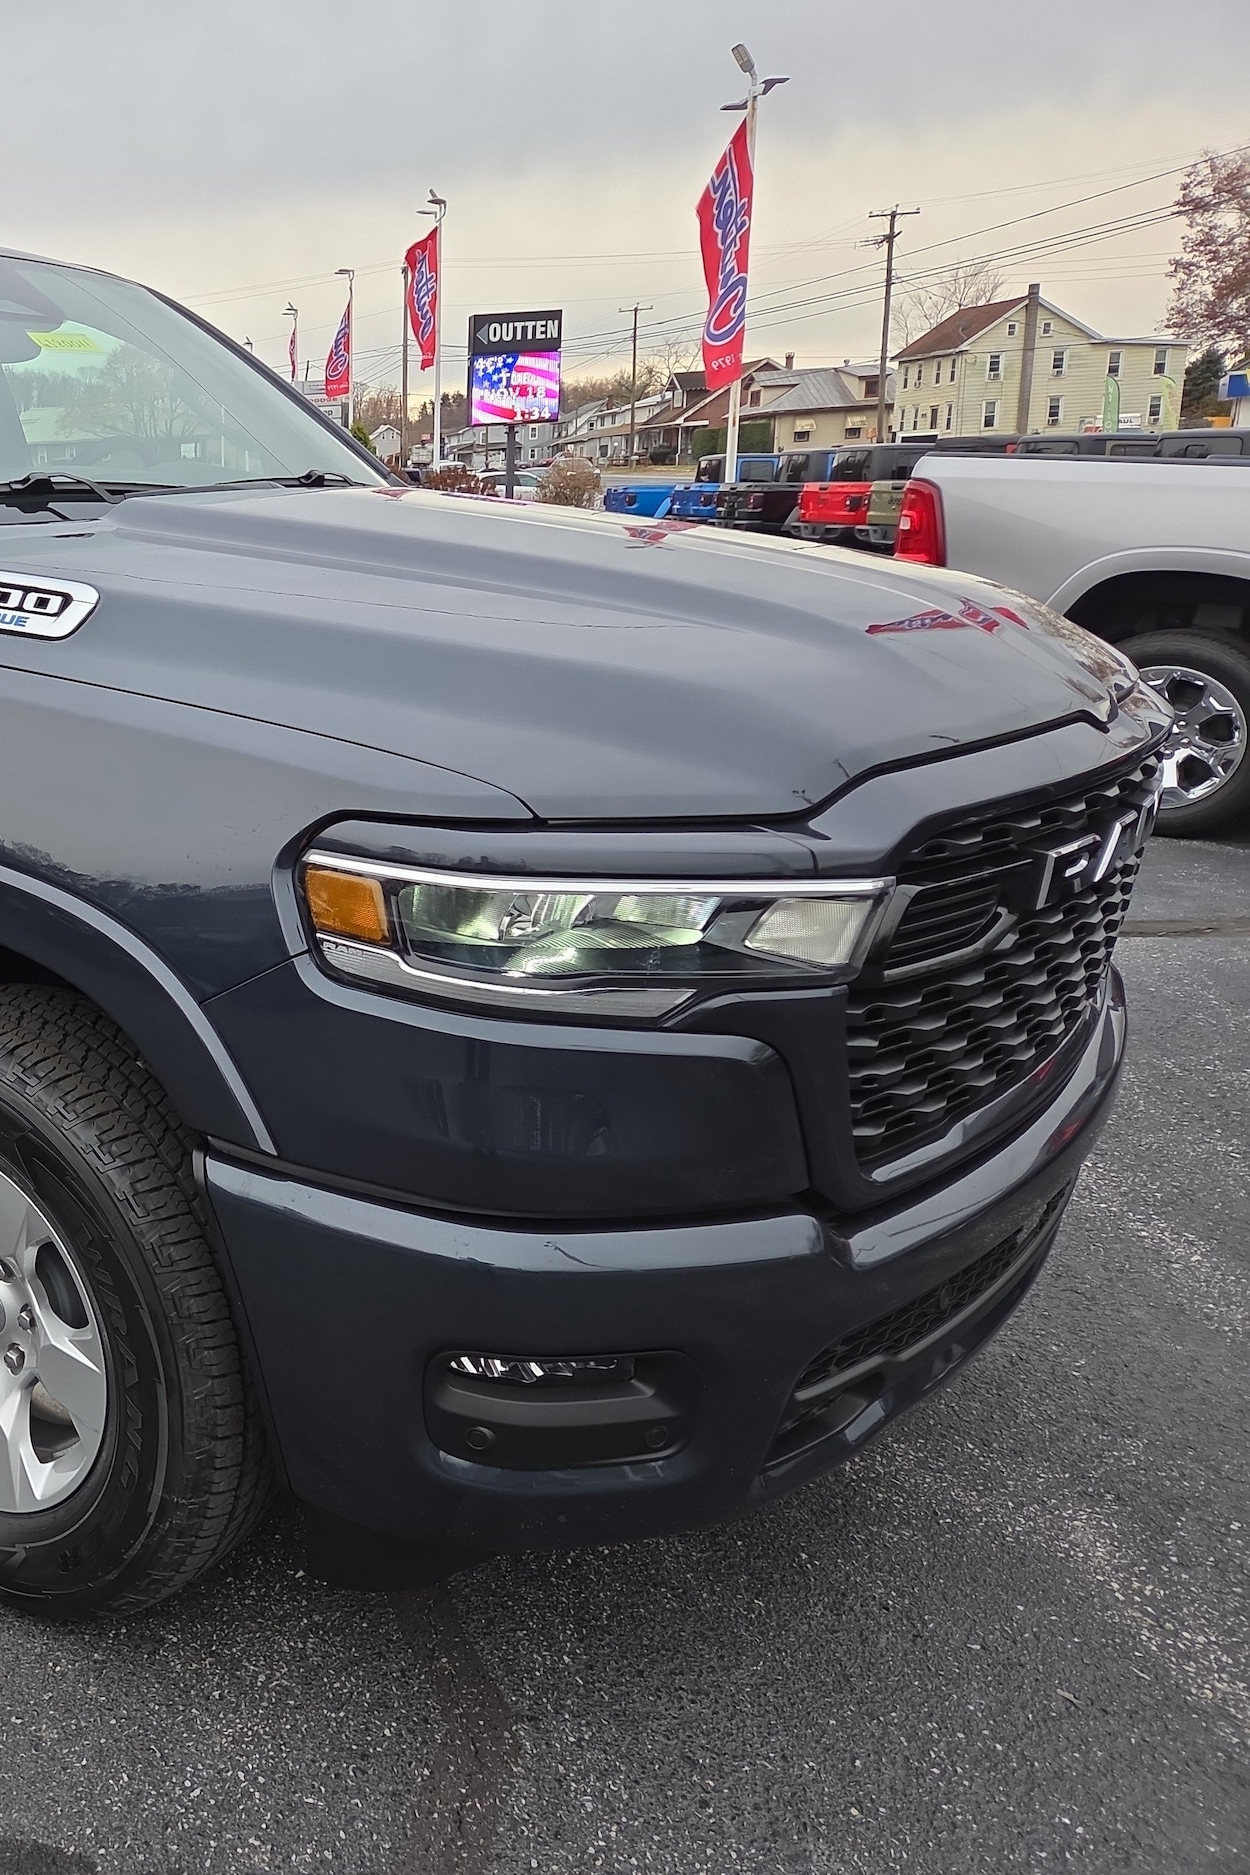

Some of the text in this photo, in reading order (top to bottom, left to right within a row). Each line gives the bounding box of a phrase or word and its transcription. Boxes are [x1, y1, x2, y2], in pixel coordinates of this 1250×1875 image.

[488, 319, 559, 343] OUTTEN
[528, 386, 549, 400] 18
[514, 407, 551, 422] 1:34
